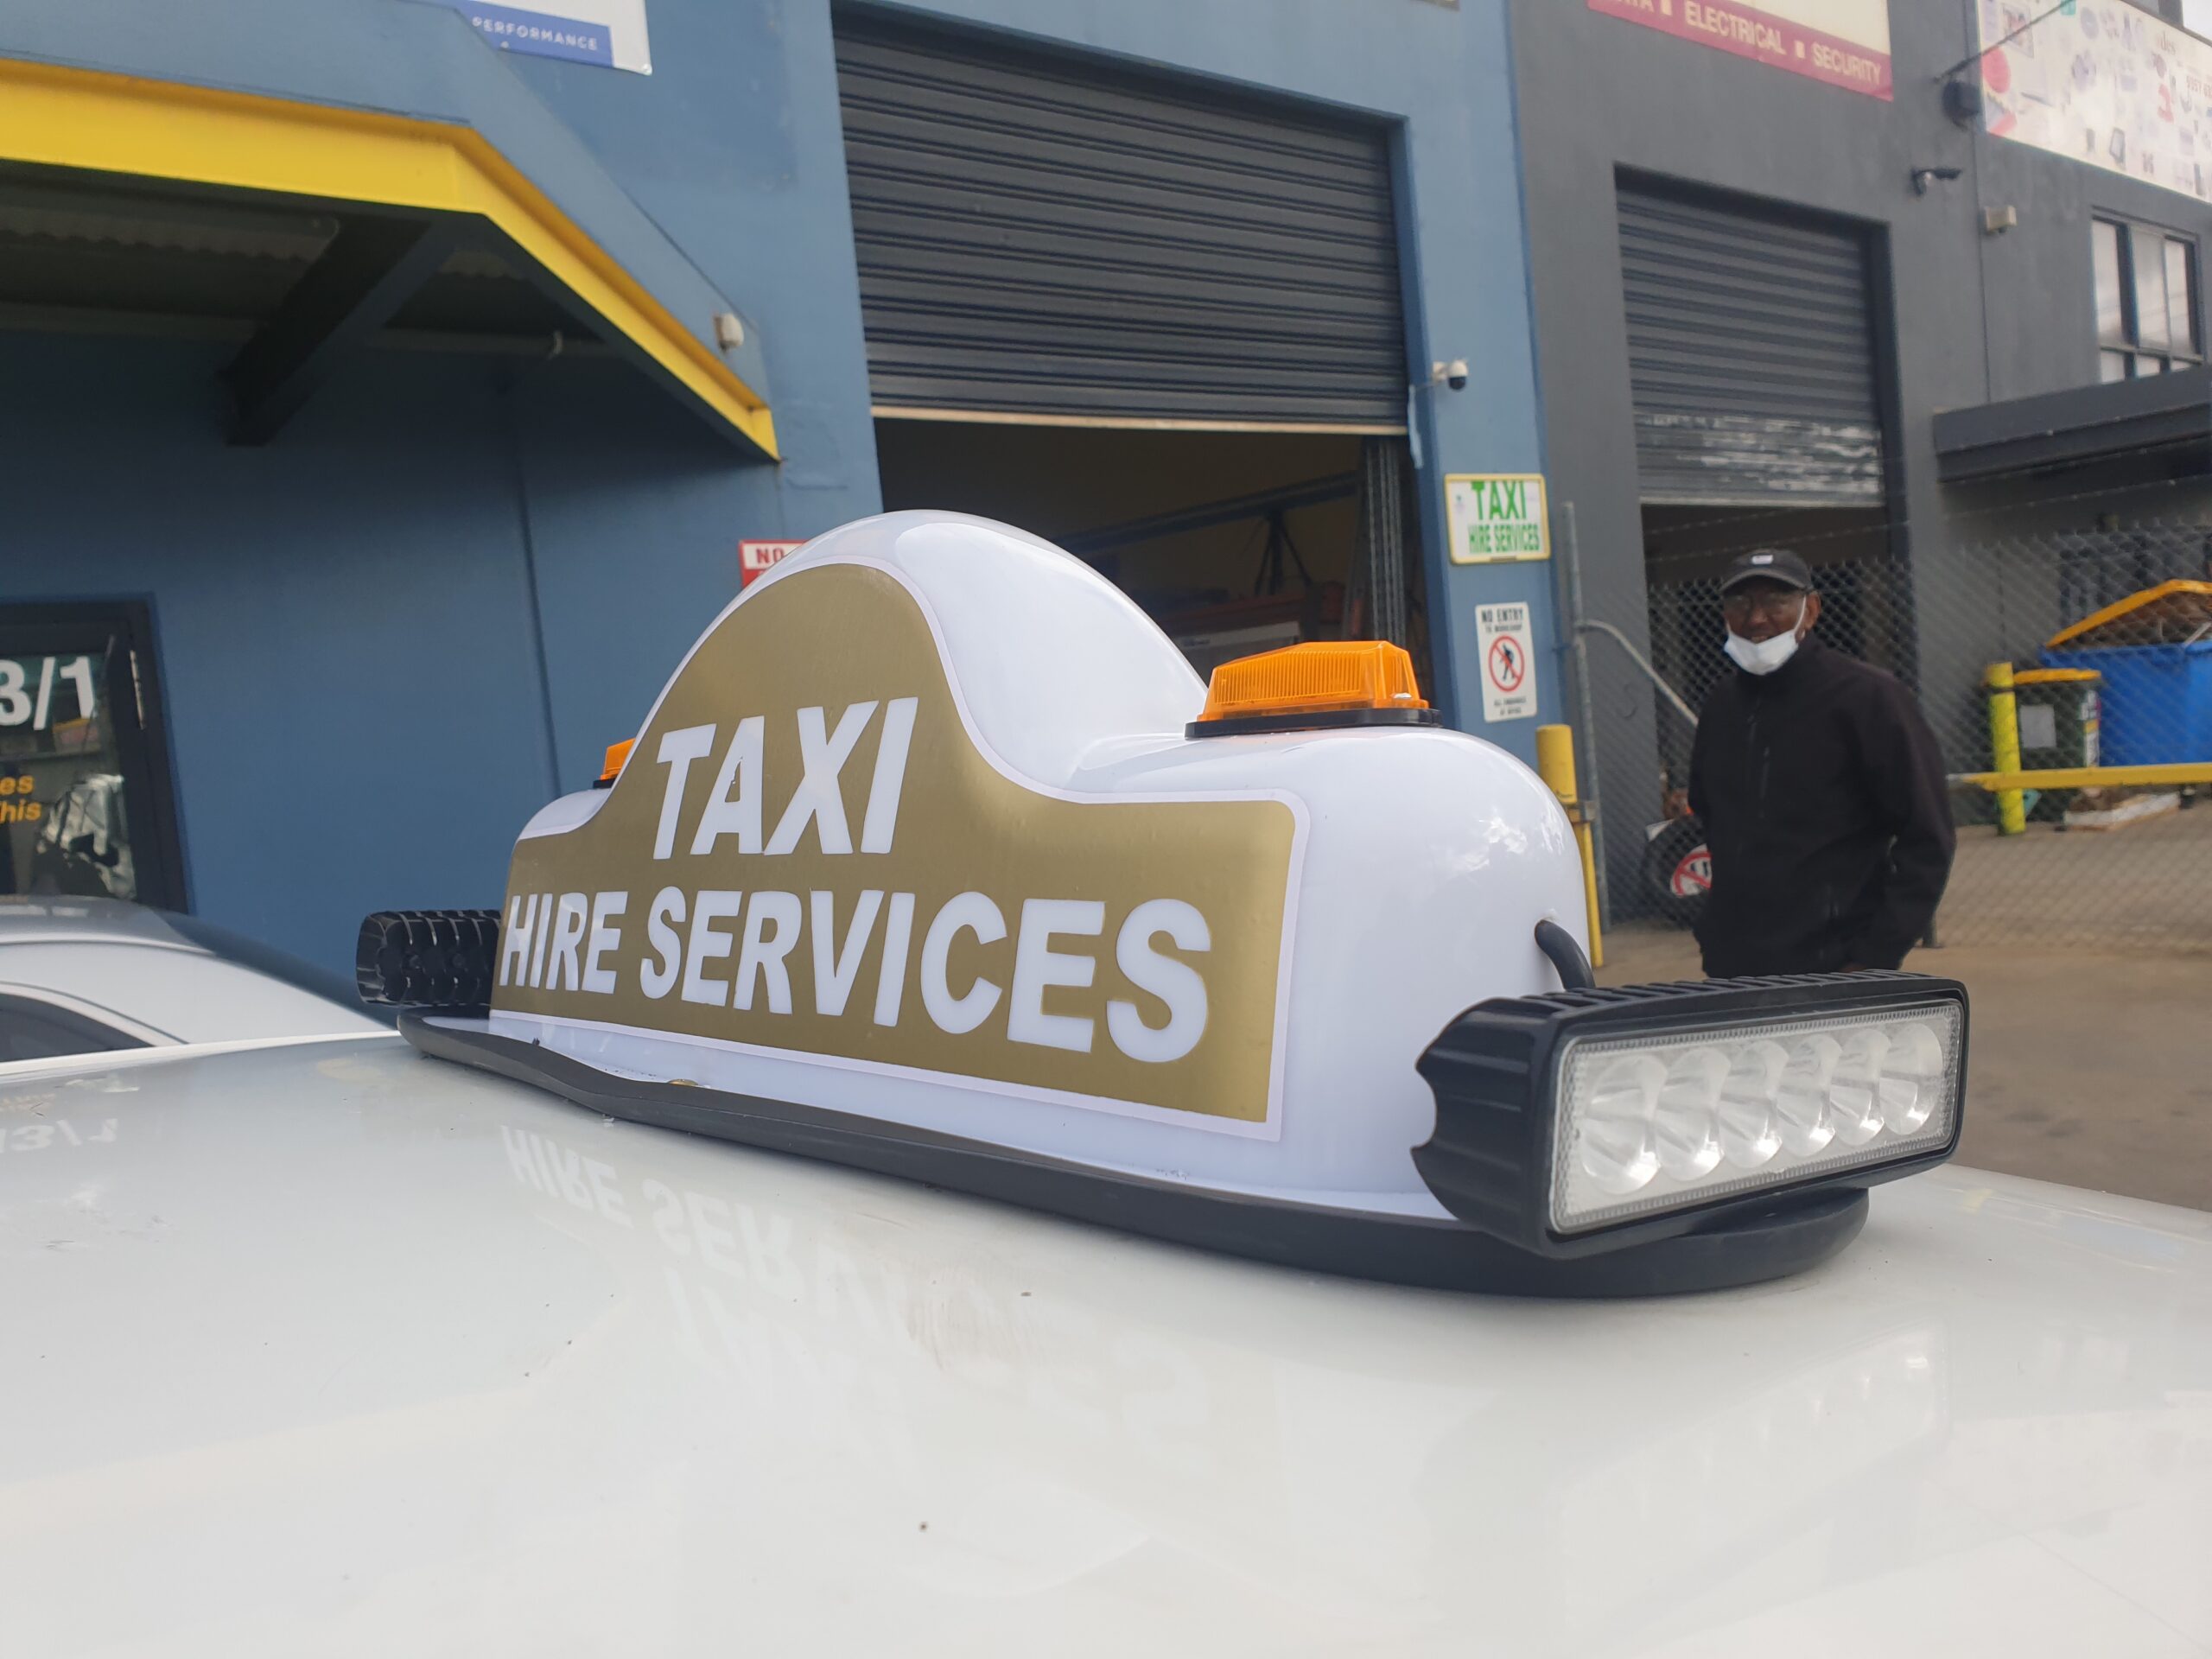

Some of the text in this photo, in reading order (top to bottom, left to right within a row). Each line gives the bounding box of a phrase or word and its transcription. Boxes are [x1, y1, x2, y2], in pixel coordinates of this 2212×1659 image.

[472, 16, 598, 50] PERFORMANCE
[1684, 1, 1882, 86] ELECTRICAL SECURITY
[1471, 480, 1527, 520] TAXI
[1468, 523, 1540, 553] HIRE SERVICES
[1481, 607, 1523, 623] NO ENTRY
[652, 696, 918, 860] TAXI
[499, 886, 1210, 1064] HIRE SERVICES
